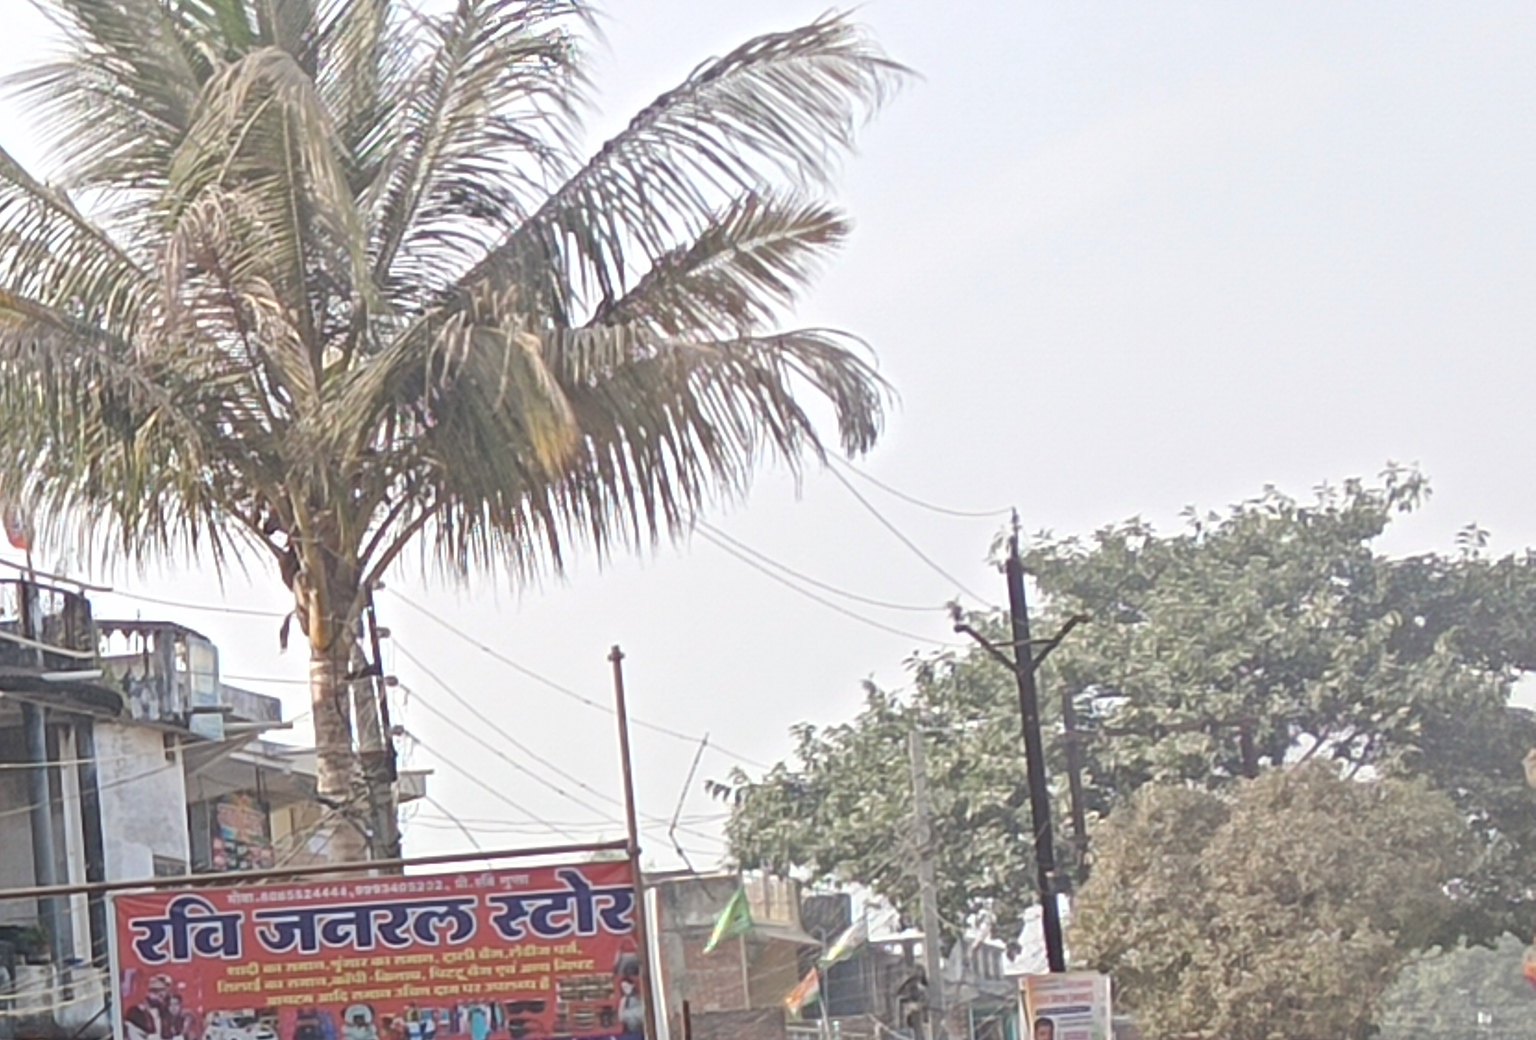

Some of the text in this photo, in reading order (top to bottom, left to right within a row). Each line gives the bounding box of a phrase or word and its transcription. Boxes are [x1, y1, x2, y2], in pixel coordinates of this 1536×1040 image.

[129, 866, 636, 965] रवि जनरल स्टोर
[262, 962, 283, 974] का
[264, 979, 284, 990] का
